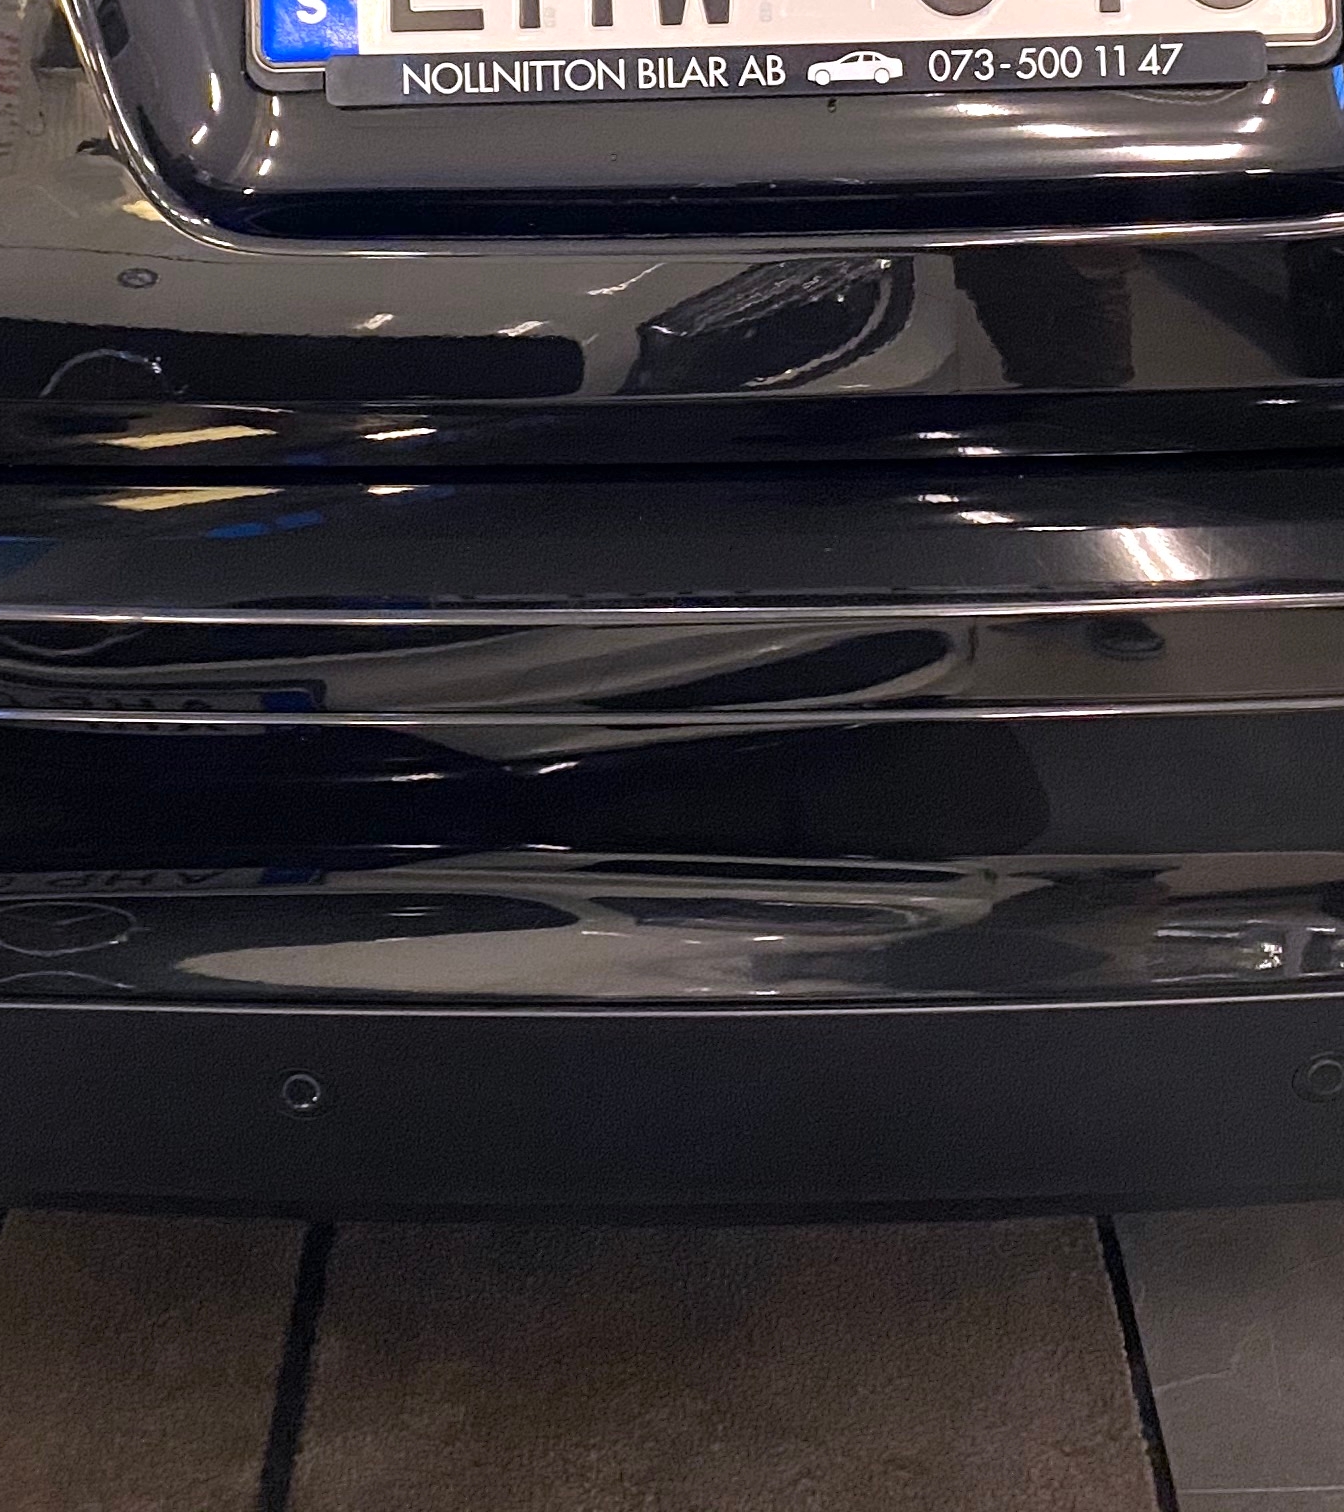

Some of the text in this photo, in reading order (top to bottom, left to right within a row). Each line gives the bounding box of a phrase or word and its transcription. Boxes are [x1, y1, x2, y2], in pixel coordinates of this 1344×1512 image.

[402, 43, 1183, 94] NOLLNITTON BILAR AB 073-500 11 47
